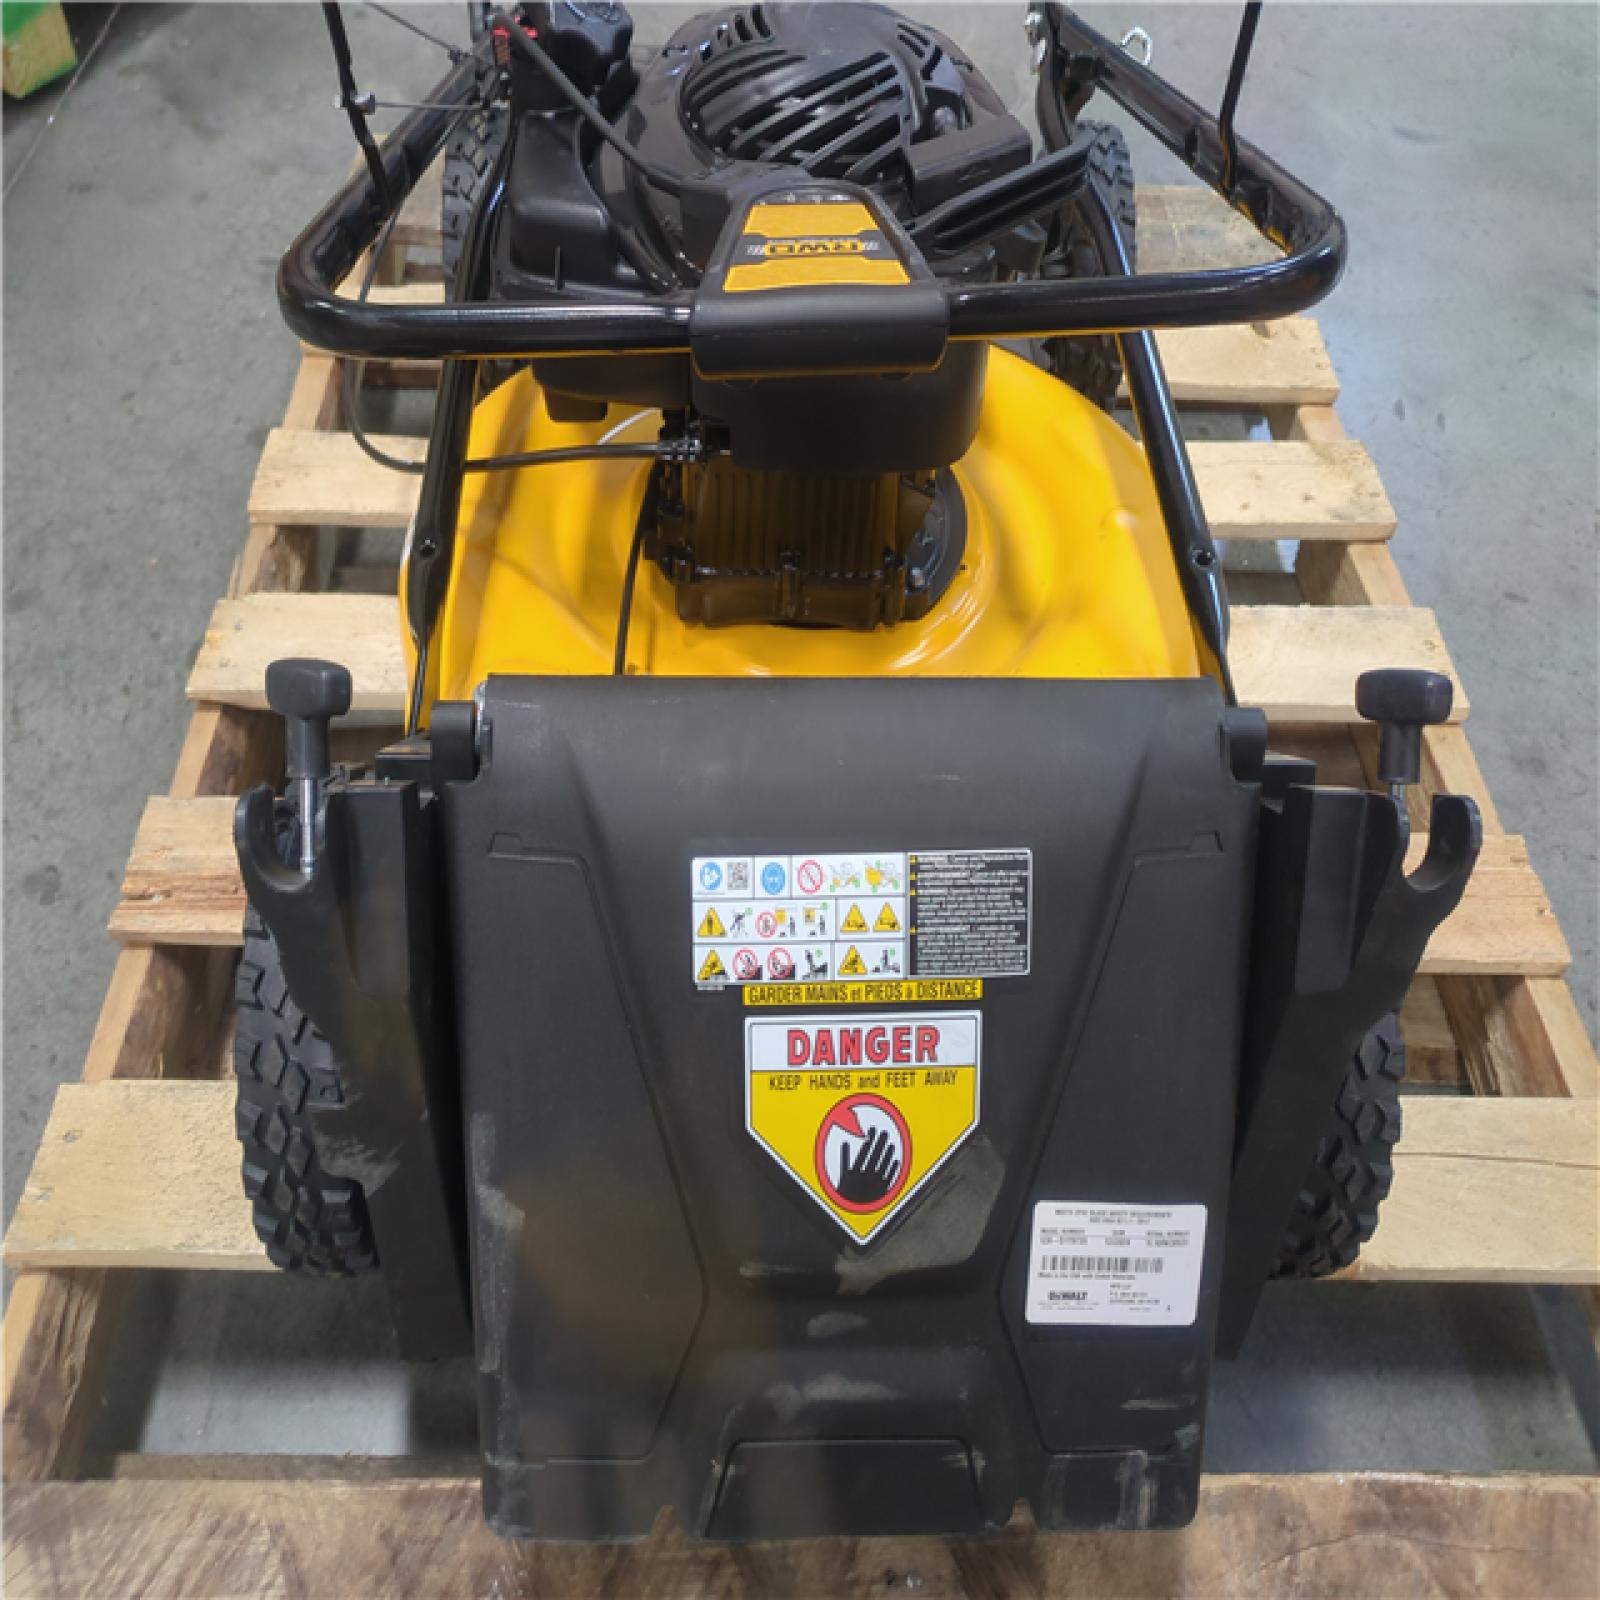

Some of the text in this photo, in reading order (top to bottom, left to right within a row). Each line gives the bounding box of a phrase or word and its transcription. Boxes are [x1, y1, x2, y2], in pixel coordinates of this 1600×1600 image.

[750, 986, 801, 1002] GARDER
[806, 985, 848, 1001] MAINS
[851, 988, 861, 1000] et
[865, 984, 902, 1000] PIEDS
[917, 982, 979, 999] DISTANCE
[787, 1025, 940, 1066] DANGER
[769, 1070, 958, 1090] KEEP HANDS and FEET AWAY
